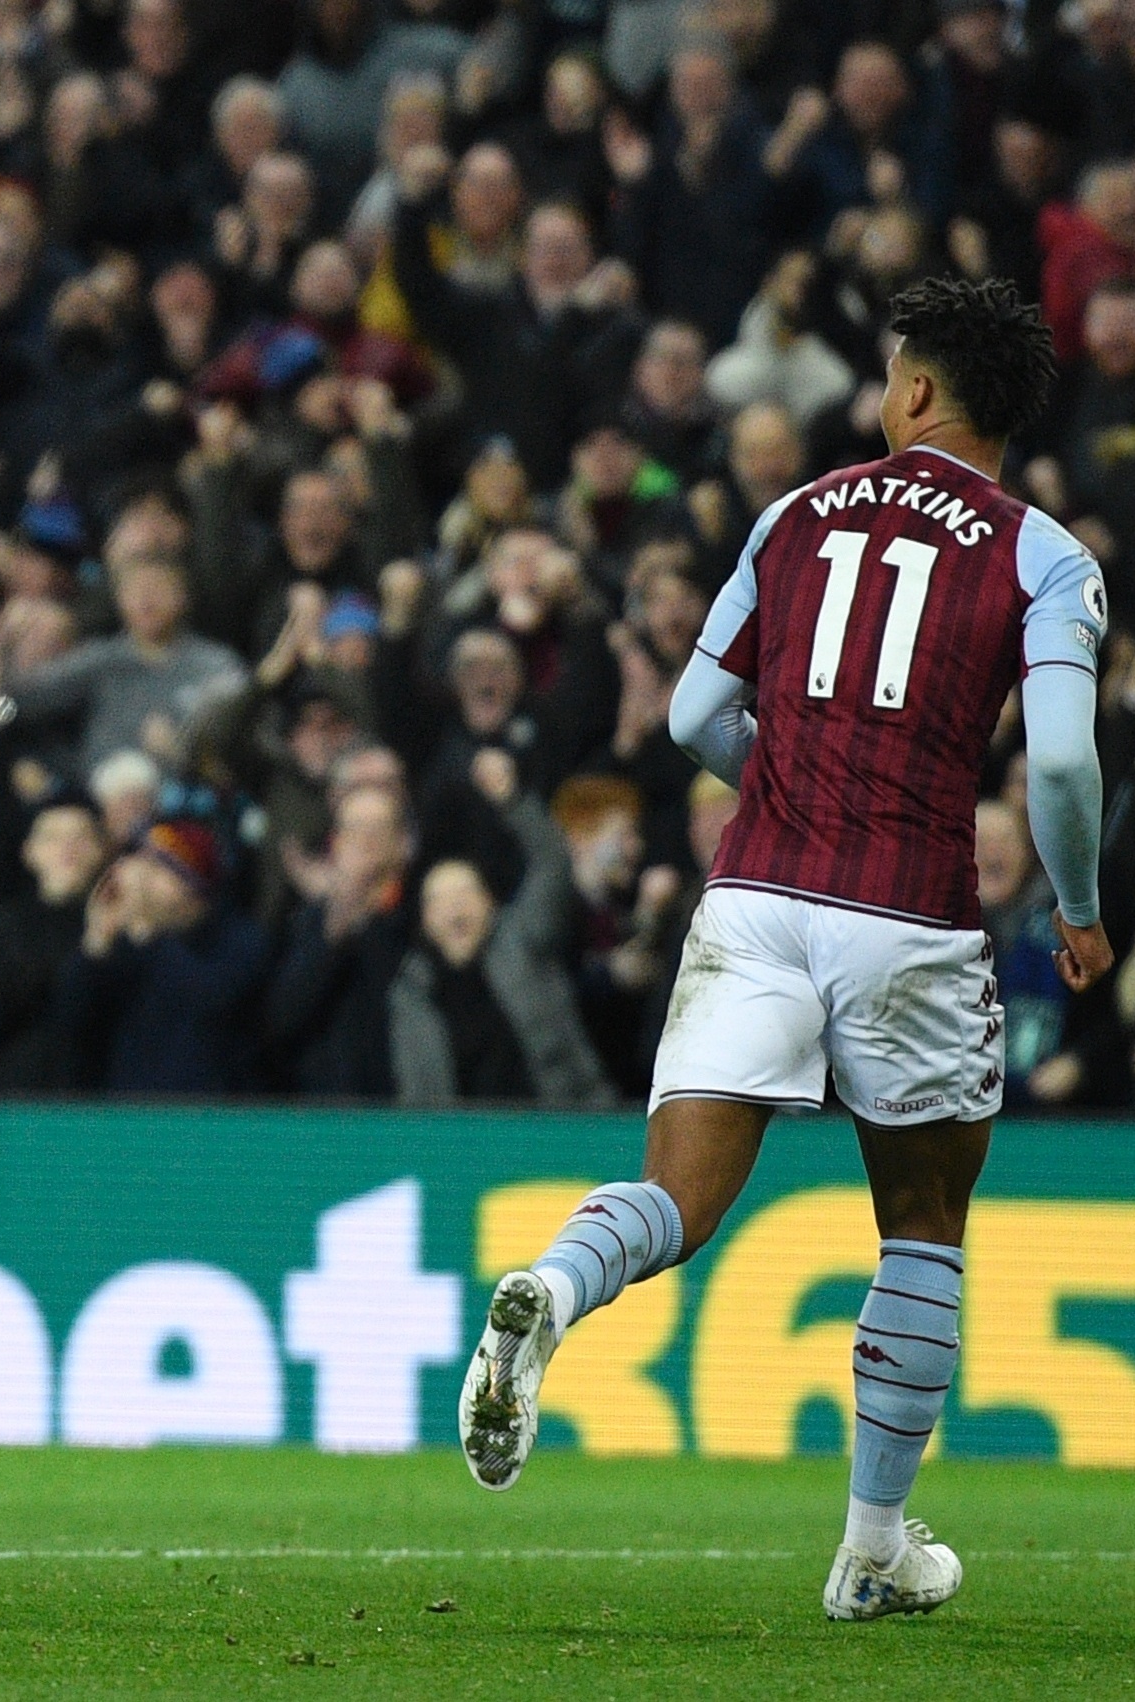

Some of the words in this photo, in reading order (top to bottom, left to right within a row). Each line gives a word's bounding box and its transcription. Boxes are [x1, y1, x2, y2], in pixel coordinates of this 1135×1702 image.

[809, 477, 993, 547] WATKINS
[807, 529, 939, 710] 11
[874, 1094, 944, 1113] Kappa
